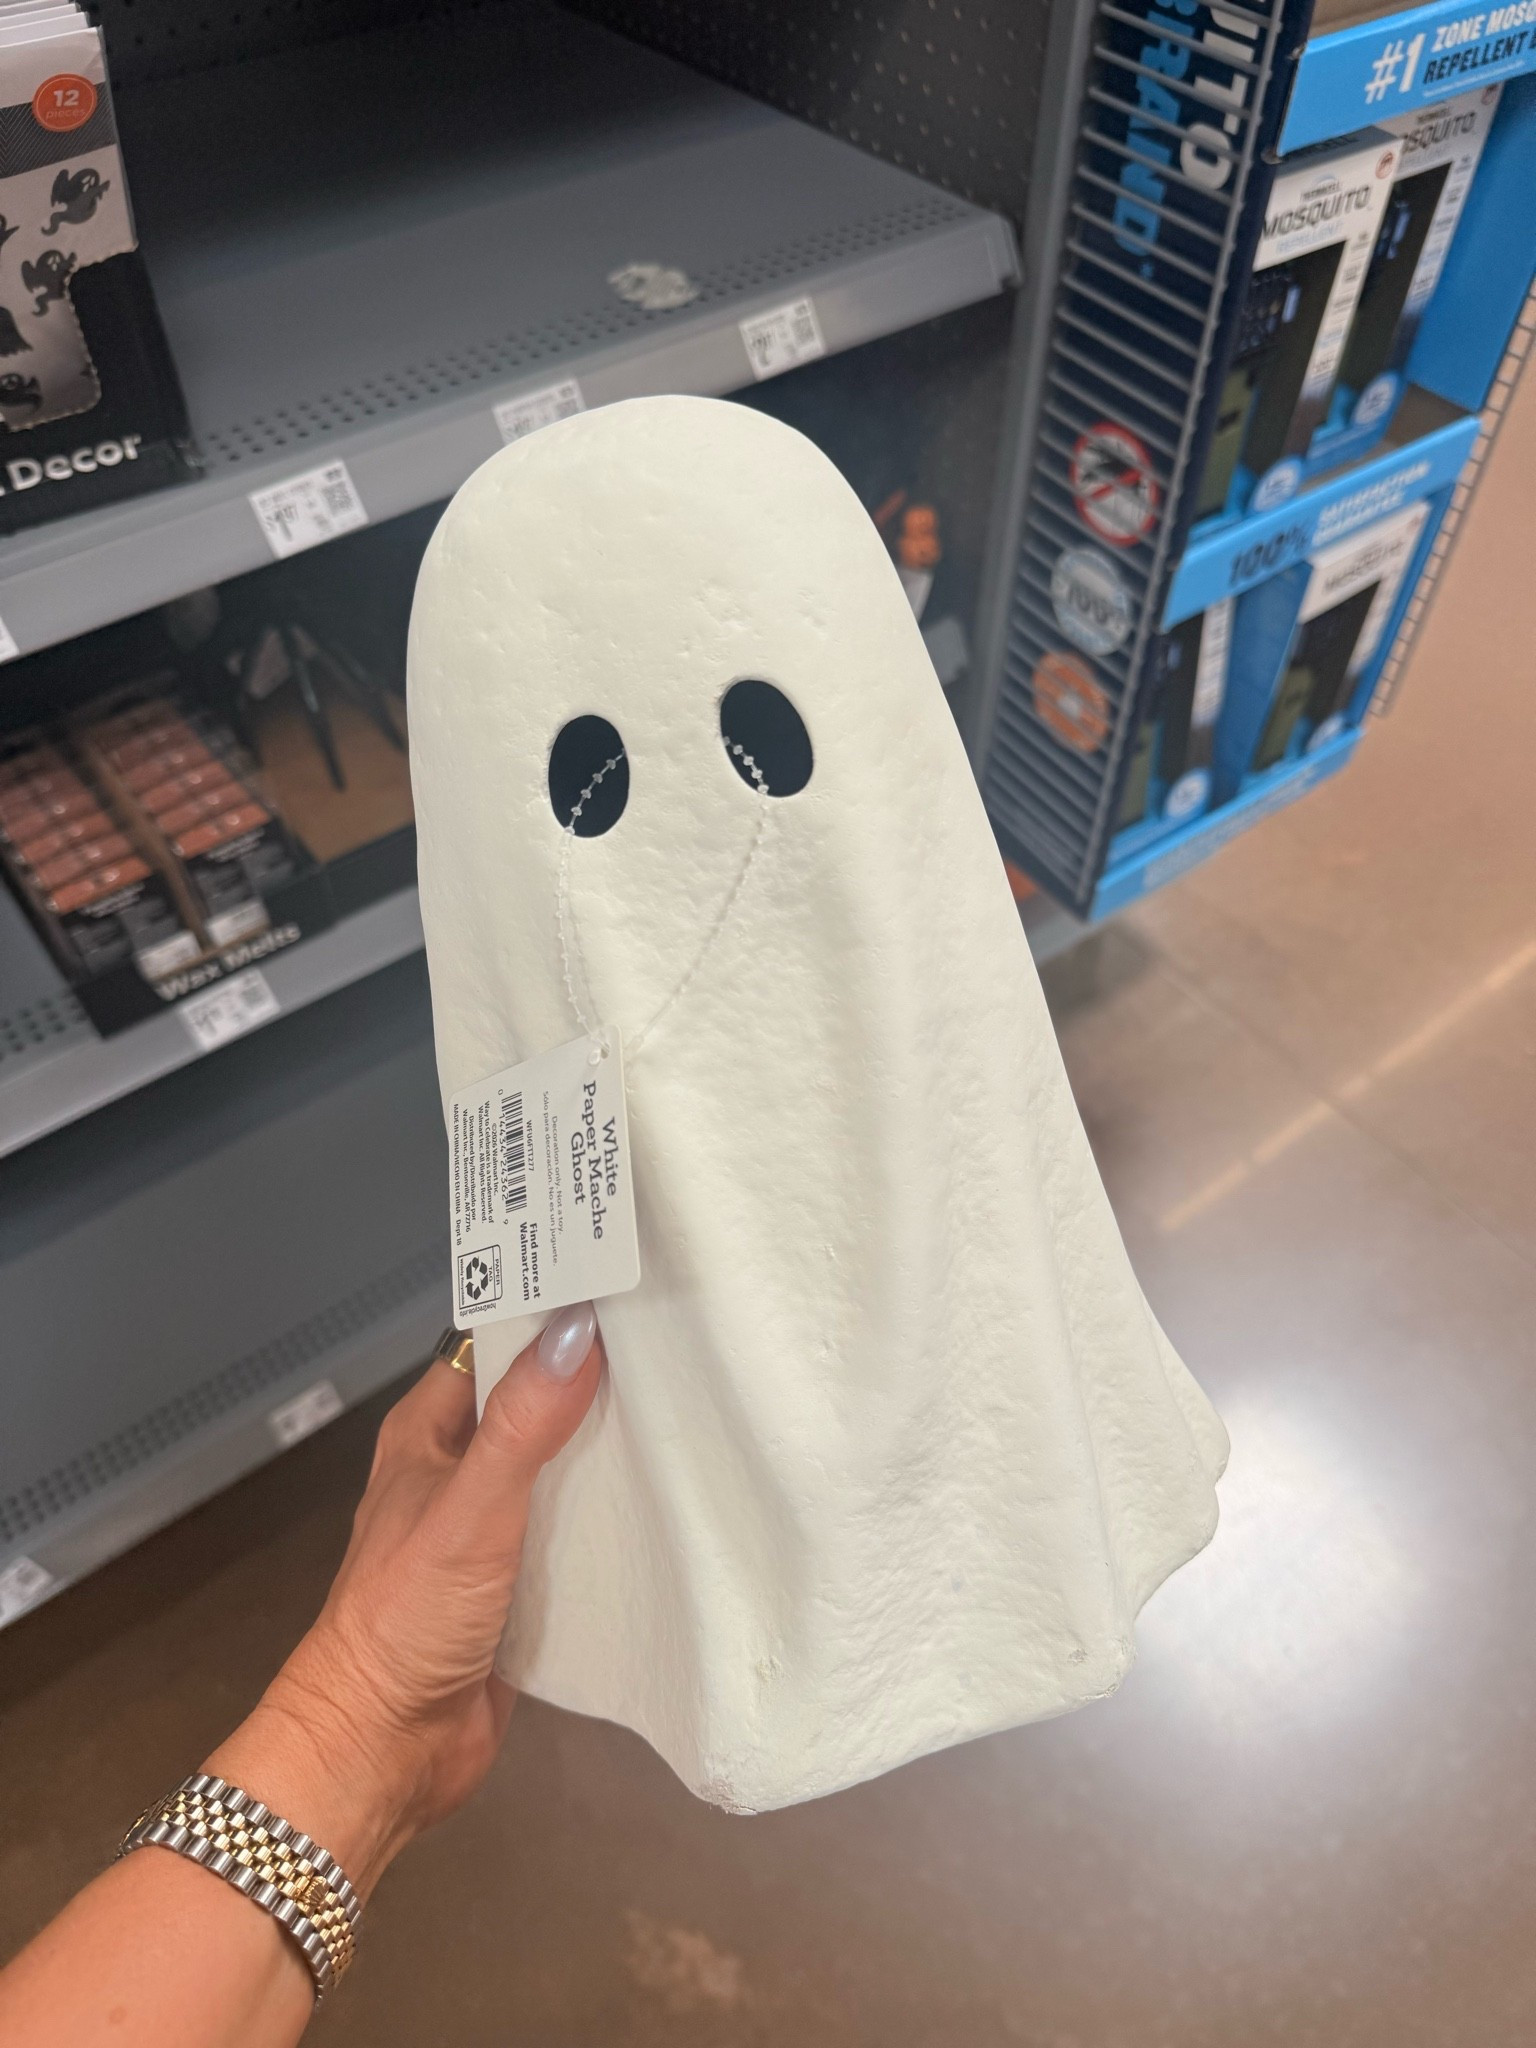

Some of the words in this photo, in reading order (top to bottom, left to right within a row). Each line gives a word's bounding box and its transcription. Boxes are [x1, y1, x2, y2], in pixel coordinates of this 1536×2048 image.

[1431, 14, 1487, 53] ZONE
[1364, 32, 1426, 104] #1
[1422, 30, 1529, 84] REPELLENT
[45, 108, 86, 120] pieces
[53, 89, 80, 107] 12
[1262, 184, 1371, 239] MOSQUITO
[6, 433, 142, 491] Decor
[155, 962, 223, 1000] Wax
[222, 922, 300, 972] Melts
[497, 1088, 503, 1096] 0
[499, 1112, 507, 1153] 14434
[582, 1080, 597, 1151] Paper
[485, 1117, 490, 1126] to
[488, 1215, 494, 1223] of
[545, 1133, 553, 1186] decoración.
[571, 1131, 586, 1205] Ghost
[603, 1116, 619, 1196] White
[500, 1159, 508, 1201] 24362
[548, 1186, 554, 1200] No
[588, 1156, 607, 1240] Mache
[549, 1201, 554, 1212] es
[550, 1213, 555, 1227] un
[530, 1222, 539, 1249] Find
[550, 1227, 559, 1266] juguete.
[520, 1221, 530, 1301] Walmart.com
[531, 1251, 539, 1283] more
[533, 1285, 541, 1299] at
